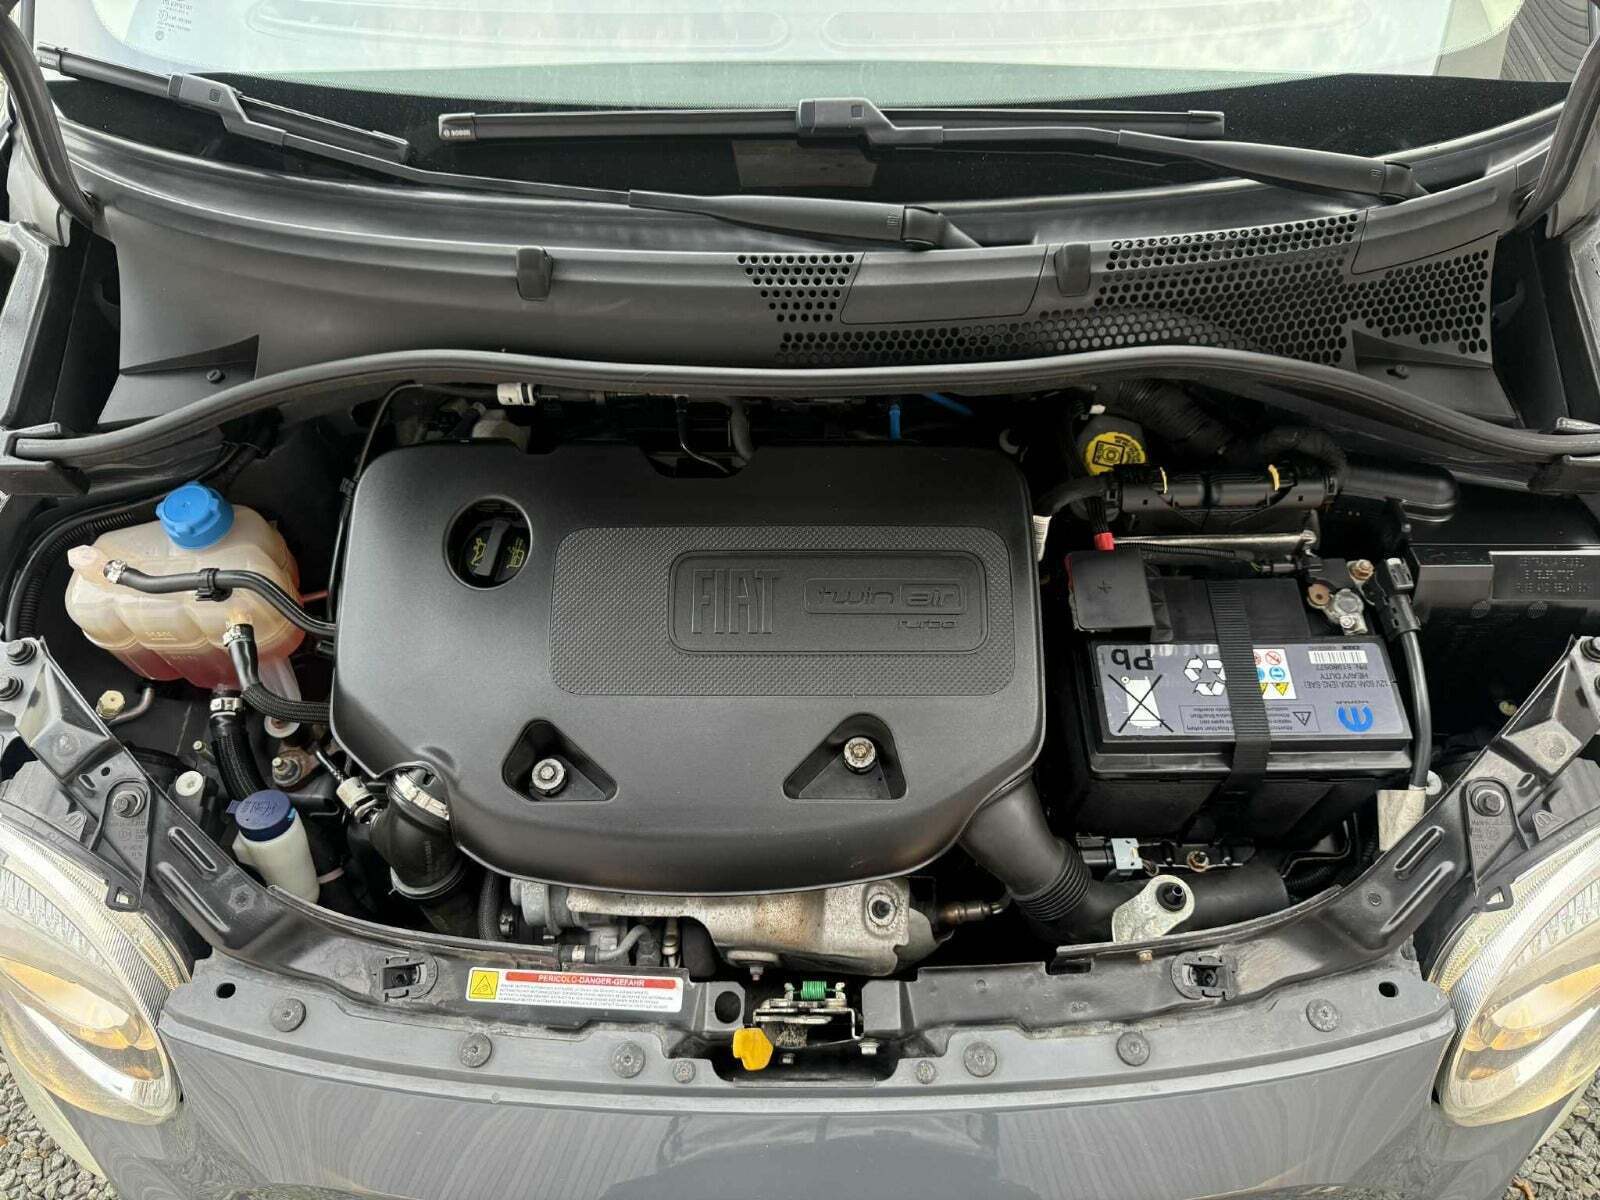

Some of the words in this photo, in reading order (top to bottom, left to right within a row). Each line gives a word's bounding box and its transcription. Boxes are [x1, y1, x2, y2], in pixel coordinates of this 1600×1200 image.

[691, 568, 785, 635] FIAT
[1110, 648, 1154, 671] Pb
[1320, 672, 1342, 680] DUTY
[1343, 672, 1369, 680] HEAVY
[537, 974, 646, 987] PERICOLO-DANGER-GEFAHR
